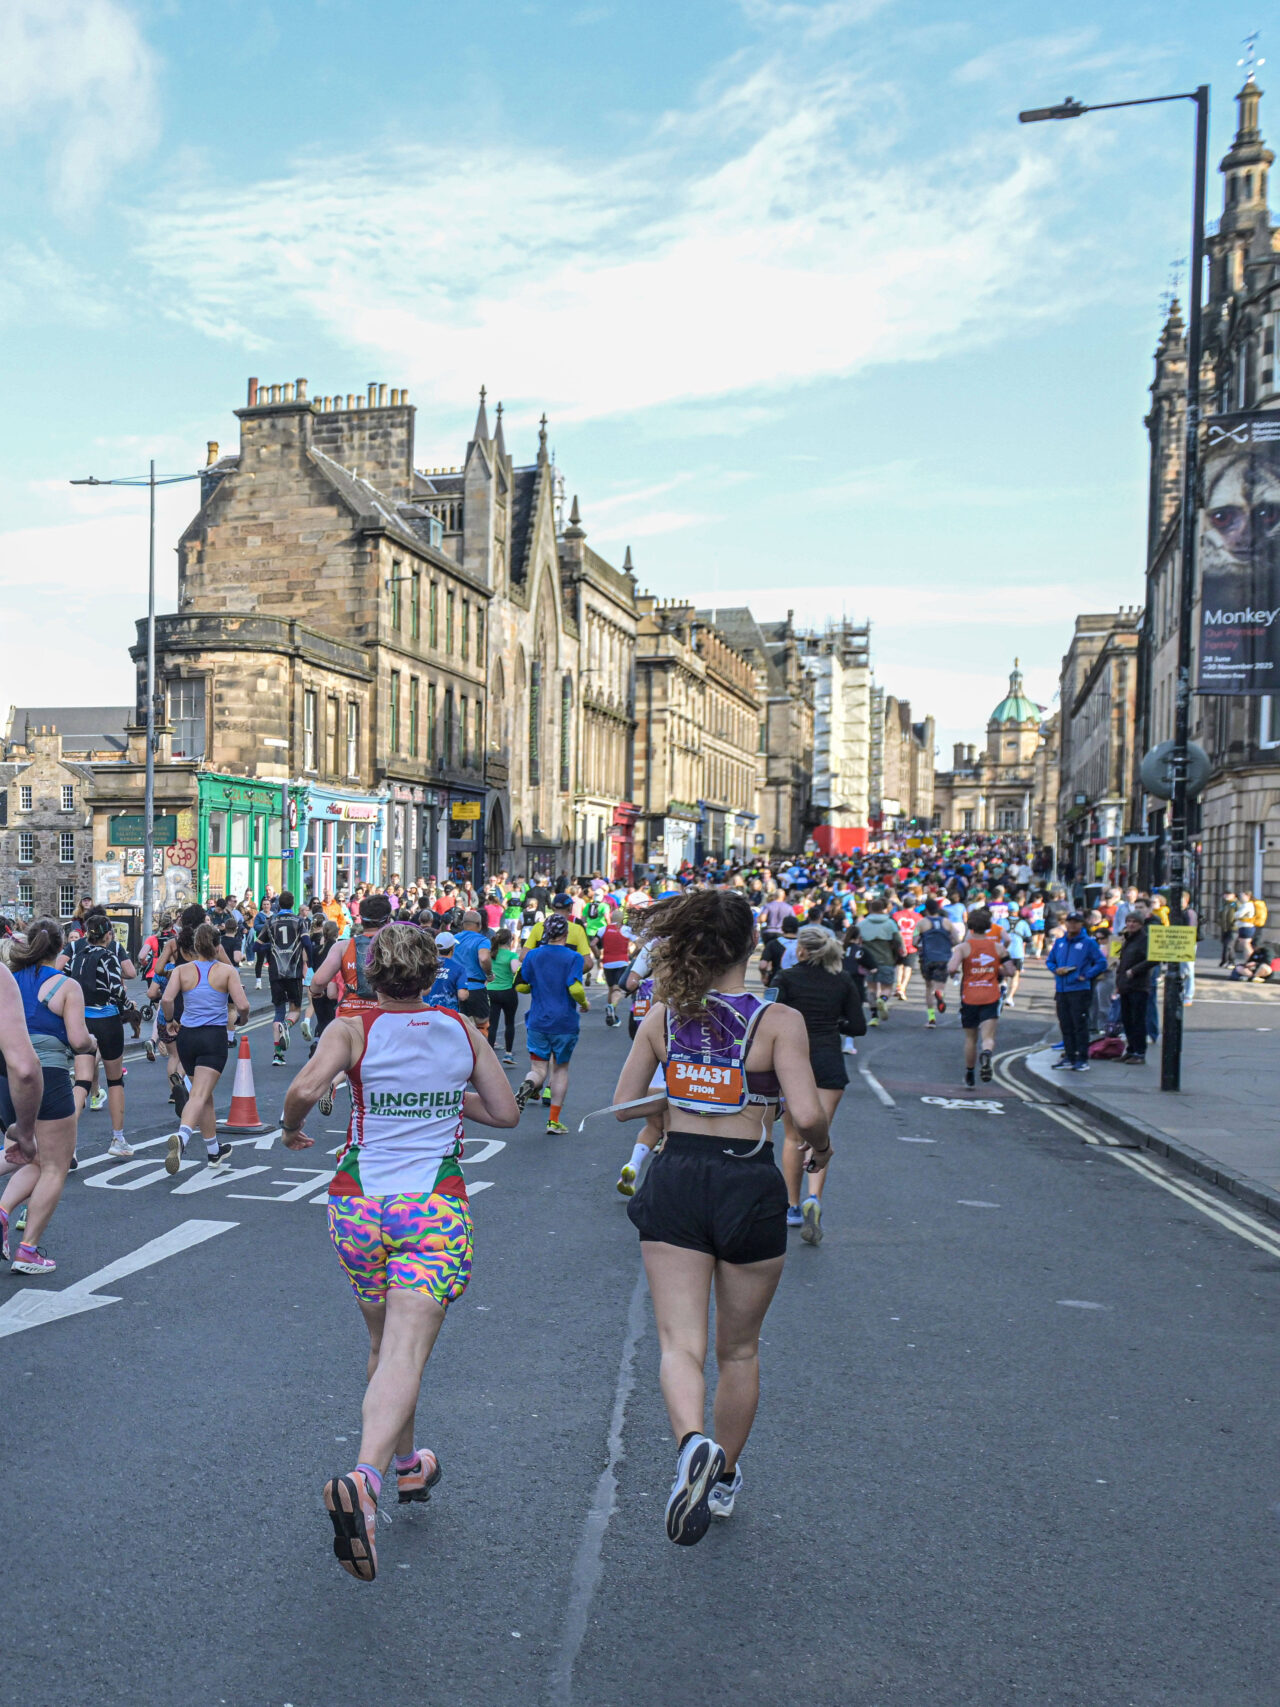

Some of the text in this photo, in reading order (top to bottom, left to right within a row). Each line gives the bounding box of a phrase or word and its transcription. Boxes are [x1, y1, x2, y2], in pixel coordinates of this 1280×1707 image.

[1204, 607, 1280, 626] Monkey
[278, 925, 288, 945] 1
[675, 1063, 731, 1085] 34431
[370, 1089, 462, 1107] LINGFIELD
[689, 1084, 715, 1095] FFION
[369, 1106, 431, 1119] RUNNING
